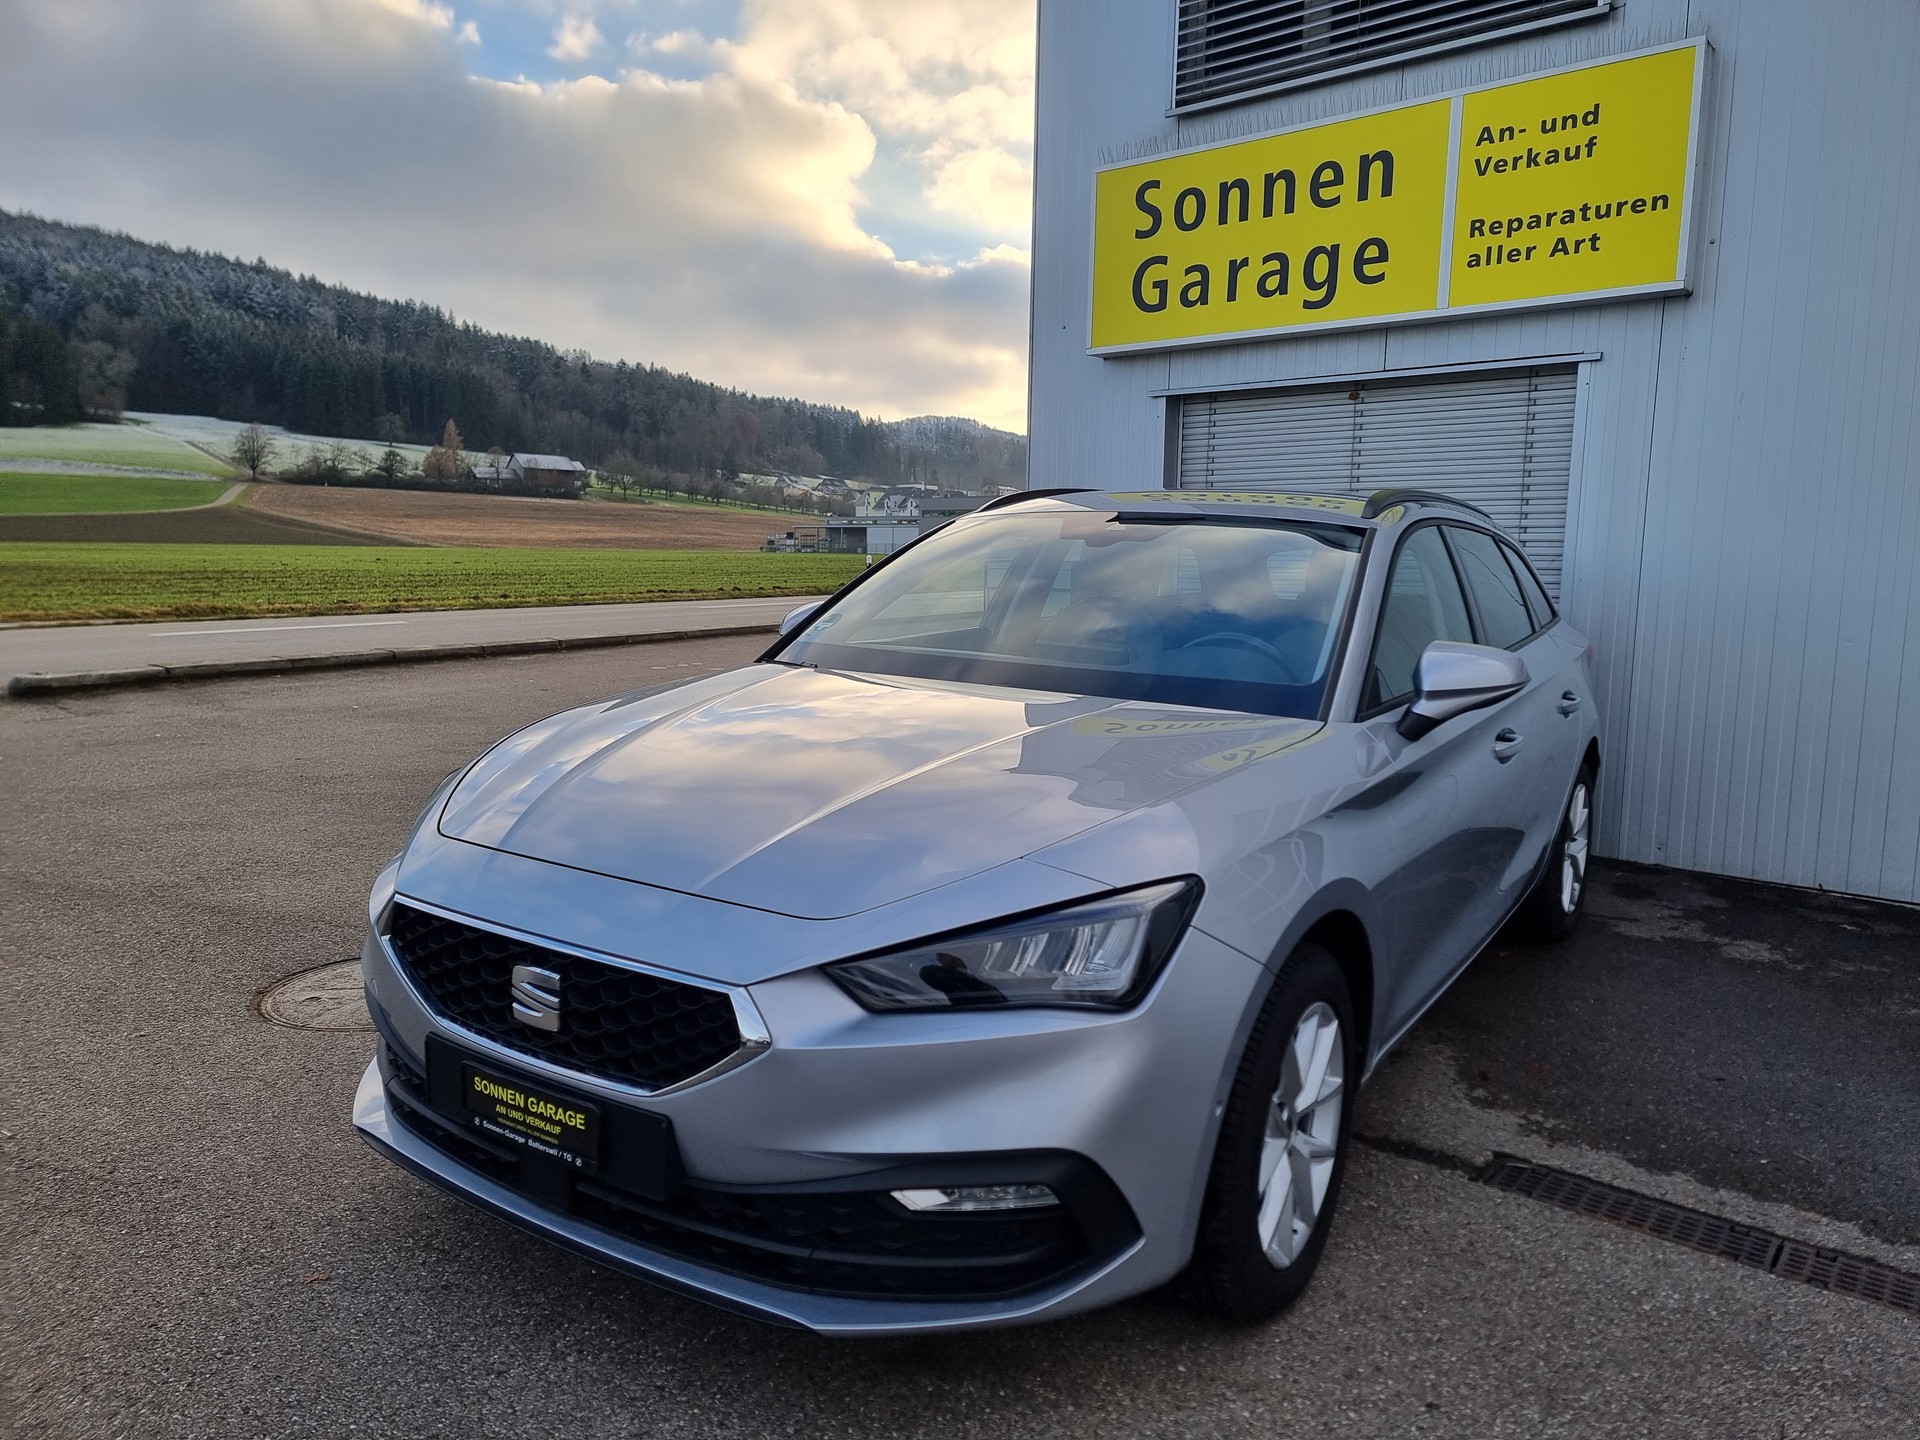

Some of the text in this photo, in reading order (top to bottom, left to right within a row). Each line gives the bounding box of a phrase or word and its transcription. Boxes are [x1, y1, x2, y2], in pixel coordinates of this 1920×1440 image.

[1475, 102, 1601, 148] An- und
[1474, 135, 1599, 177] Verkauf
[1134, 150, 1395, 240] Sonnen
[1469, 194, 1670, 239] Reparaturen
[1466, 232, 1602, 269] aller Art
[1131, 238, 1390, 314] Garage
[474, 1076, 586, 1130] SONNEN GARAGE
[495, 1104, 562, 1136] AN UND VERKAUF
[482, 1120, 526, 1144] Sonnen-Garage
[563, 1150, 573, 1163] TG
